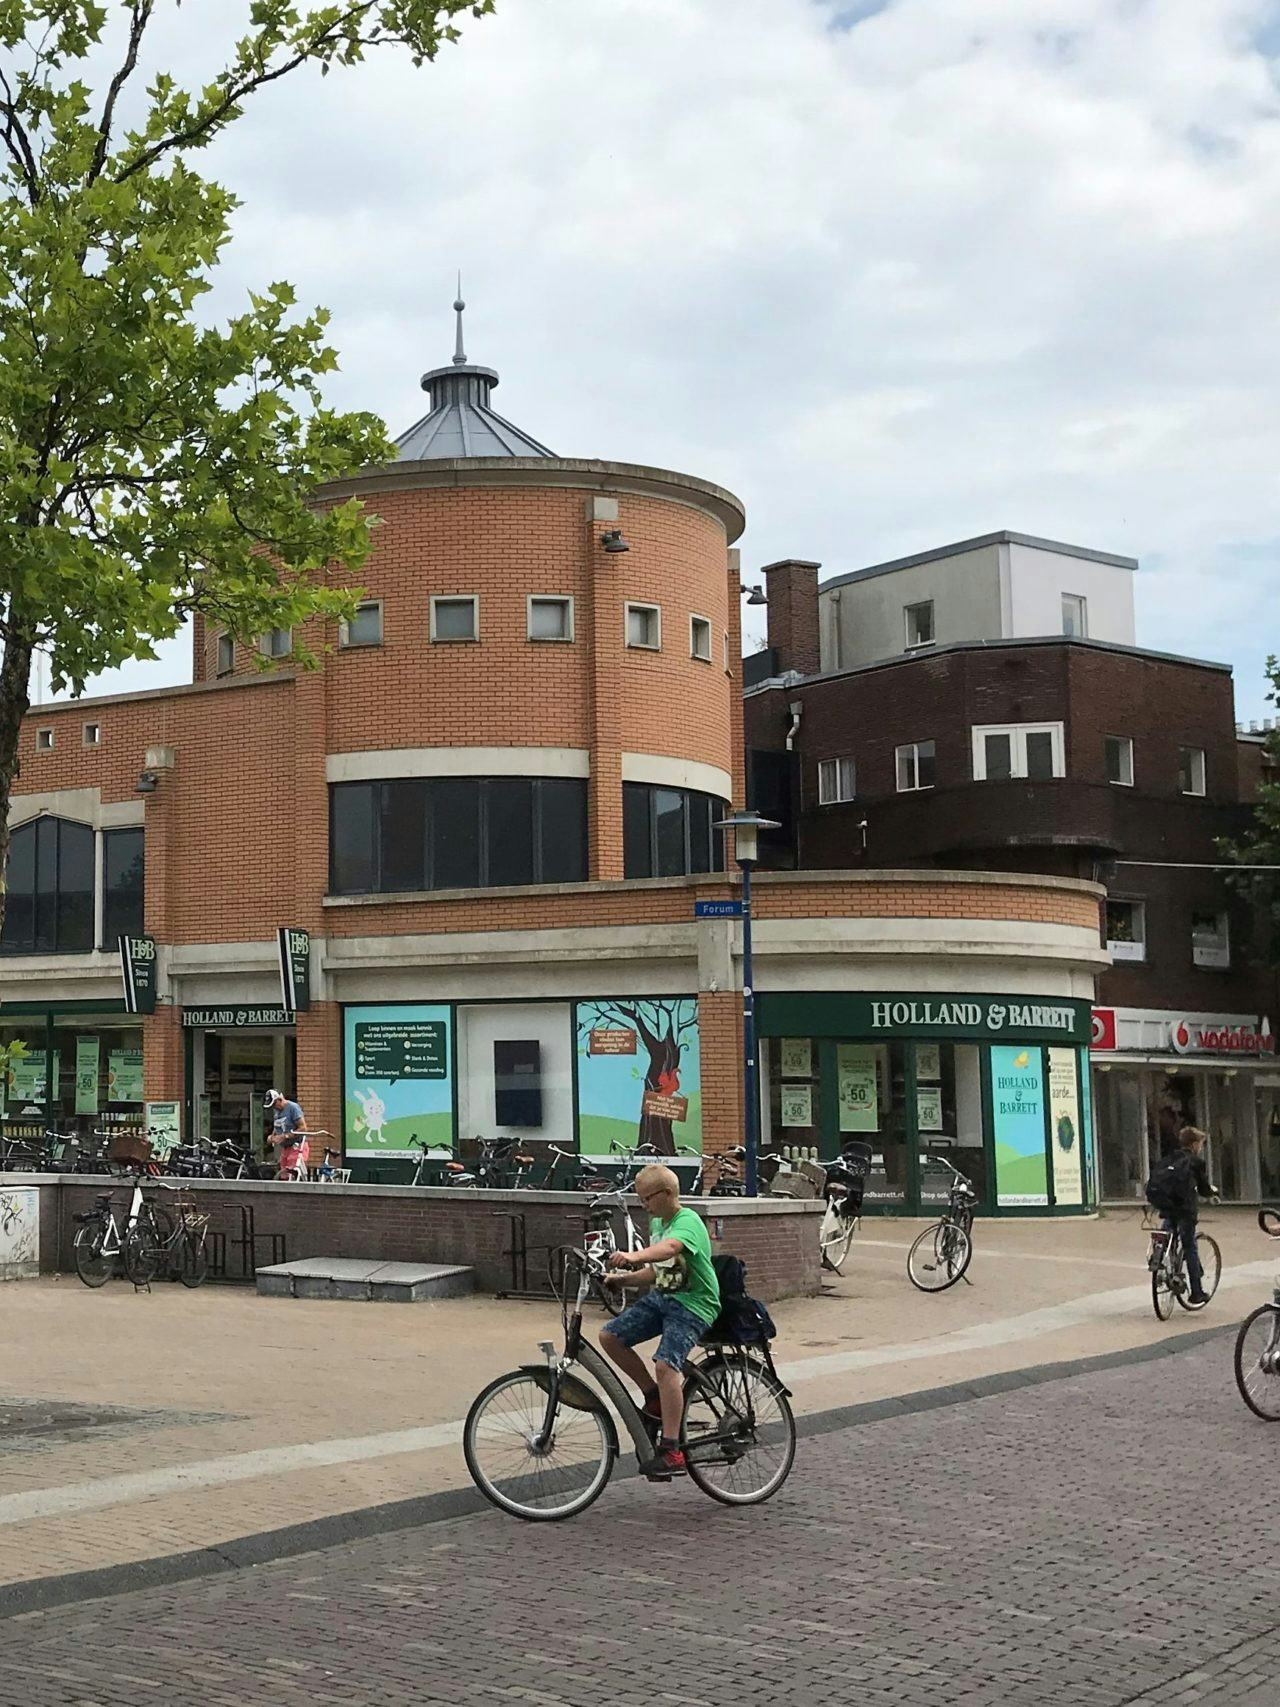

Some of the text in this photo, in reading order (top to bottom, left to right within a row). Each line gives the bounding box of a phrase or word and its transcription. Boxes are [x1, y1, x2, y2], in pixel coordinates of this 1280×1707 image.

[703, 904, 734, 914] Forum
[131, 939, 155, 960] H&B
[290, 932, 309, 955] H&B
[183, 1011, 233, 1026] HOLLAND
[235, 1010, 247, 1025] &
[871, 1002, 1076, 1033] HOLLAND & BARRETT
[998, 1077, 1038, 1090] HOLLAND
[1015, 1091, 1023, 1101] &
[1000, 1102, 1037, 1114] BARRETT
[863, 1191, 905, 1199] ndbarrett.nl
